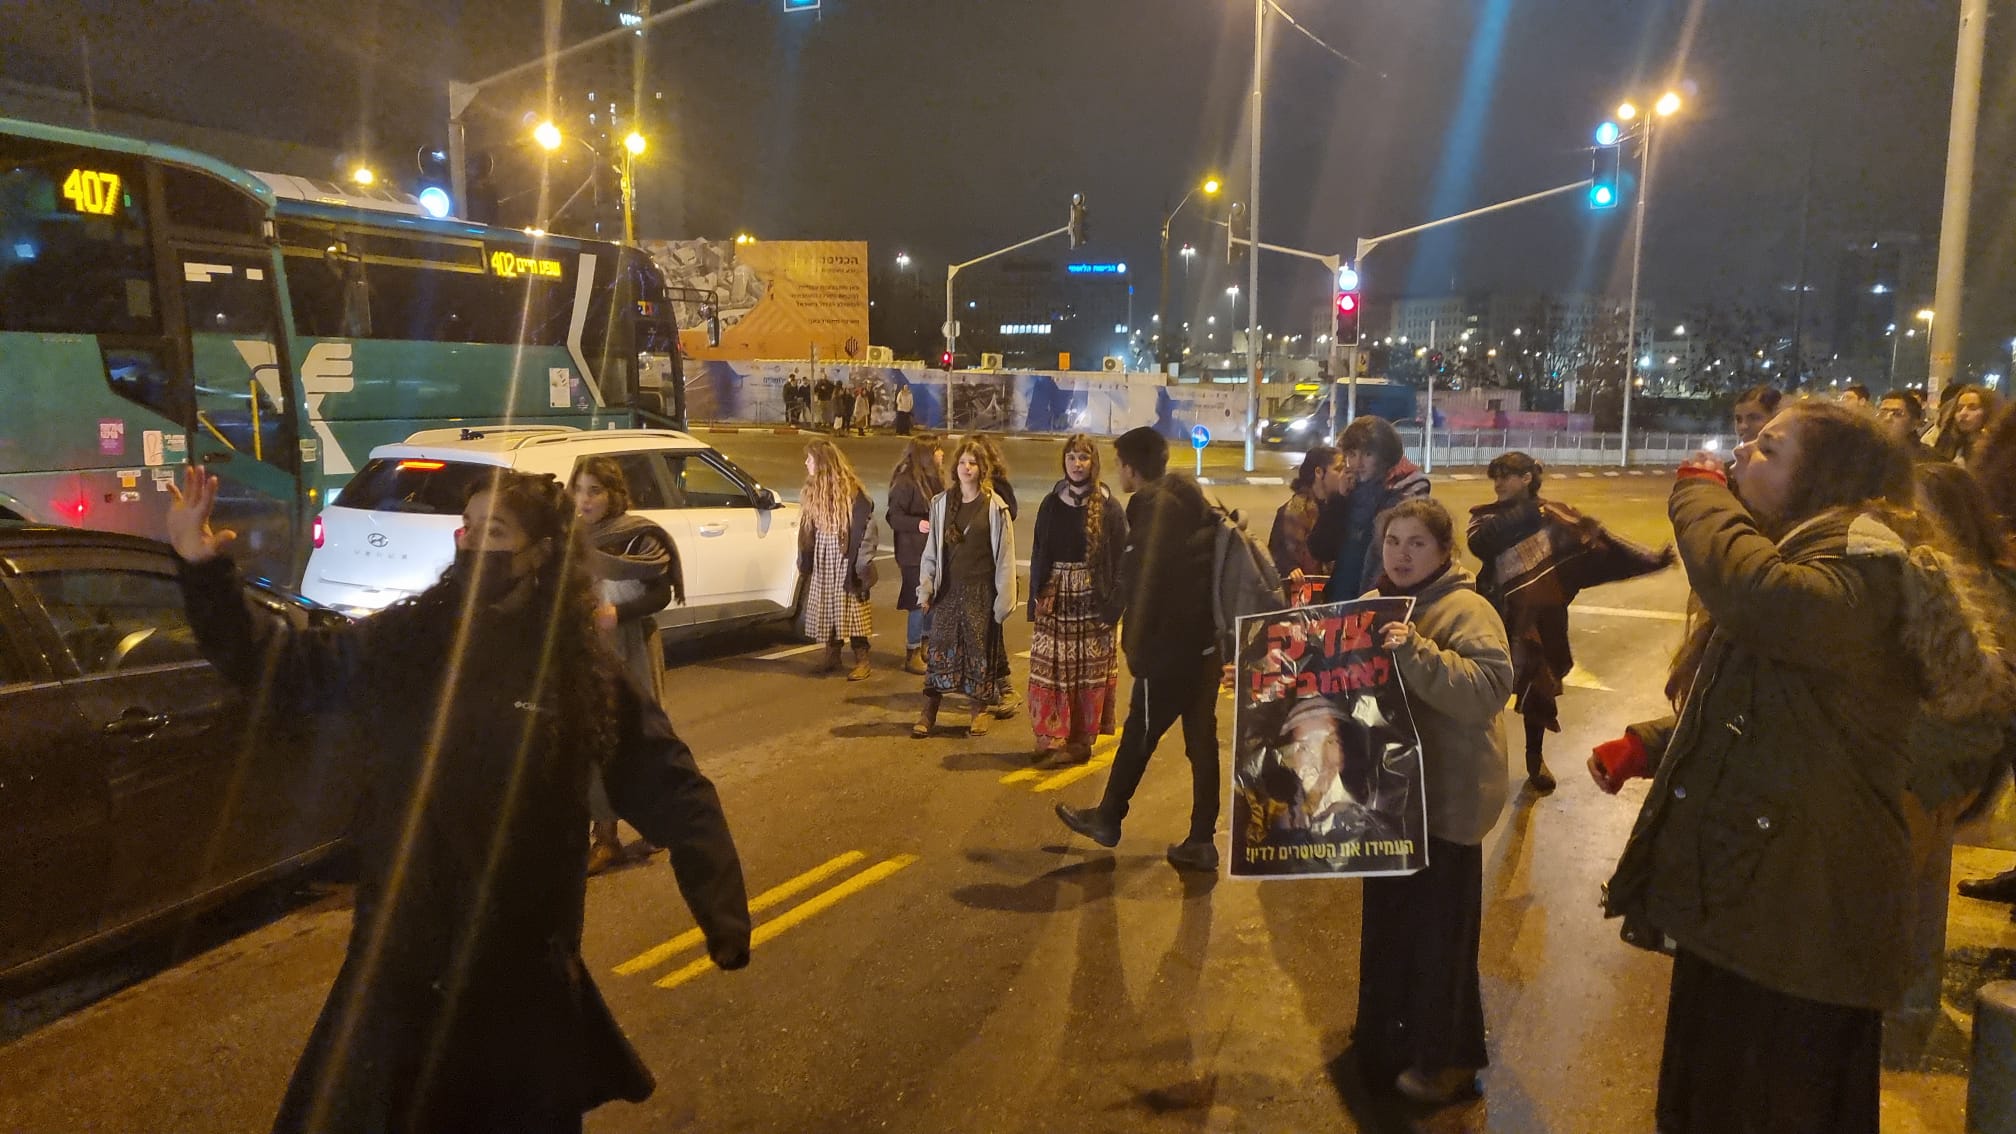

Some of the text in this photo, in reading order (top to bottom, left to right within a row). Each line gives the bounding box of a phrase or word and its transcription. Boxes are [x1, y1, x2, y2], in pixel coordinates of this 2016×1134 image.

[63, 168, 119, 215] 407
[491, 251, 517, 277] 402
[516, 257, 538, 274] חיים
[1246, 839, 1414, 863] העמידו את השוטרים לדין!
